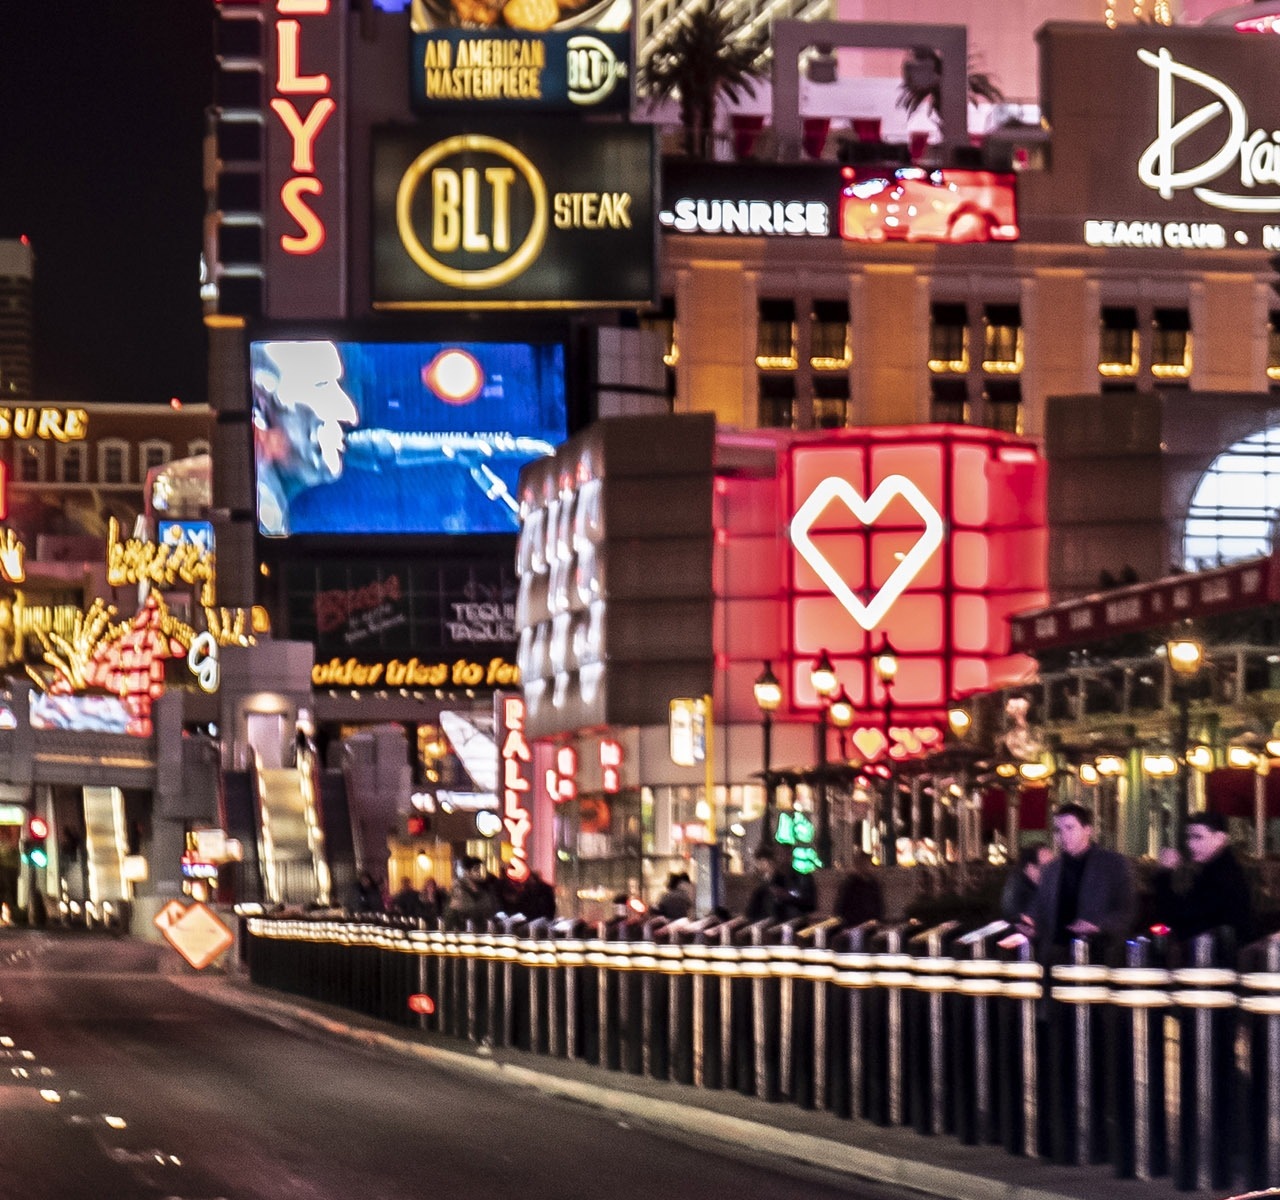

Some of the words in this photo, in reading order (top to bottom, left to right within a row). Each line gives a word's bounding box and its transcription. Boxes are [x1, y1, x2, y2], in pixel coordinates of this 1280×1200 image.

[424, 39, 450, 66] AN
[456, 39, 545, 67] AMERICAN
[566, 49, 600, 88] BLT
[425, 67, 542, 98] MASTERPIECE
[270, 0, 336, 255] LYS
[431, 167, 516, 252] BLT
[553, 192, 632, 229] STEAK
[1084, 220, 1162, 247] BEACH
[1164, 223, 1226, 248] CLUB
[452, 659, 484, 685] to
